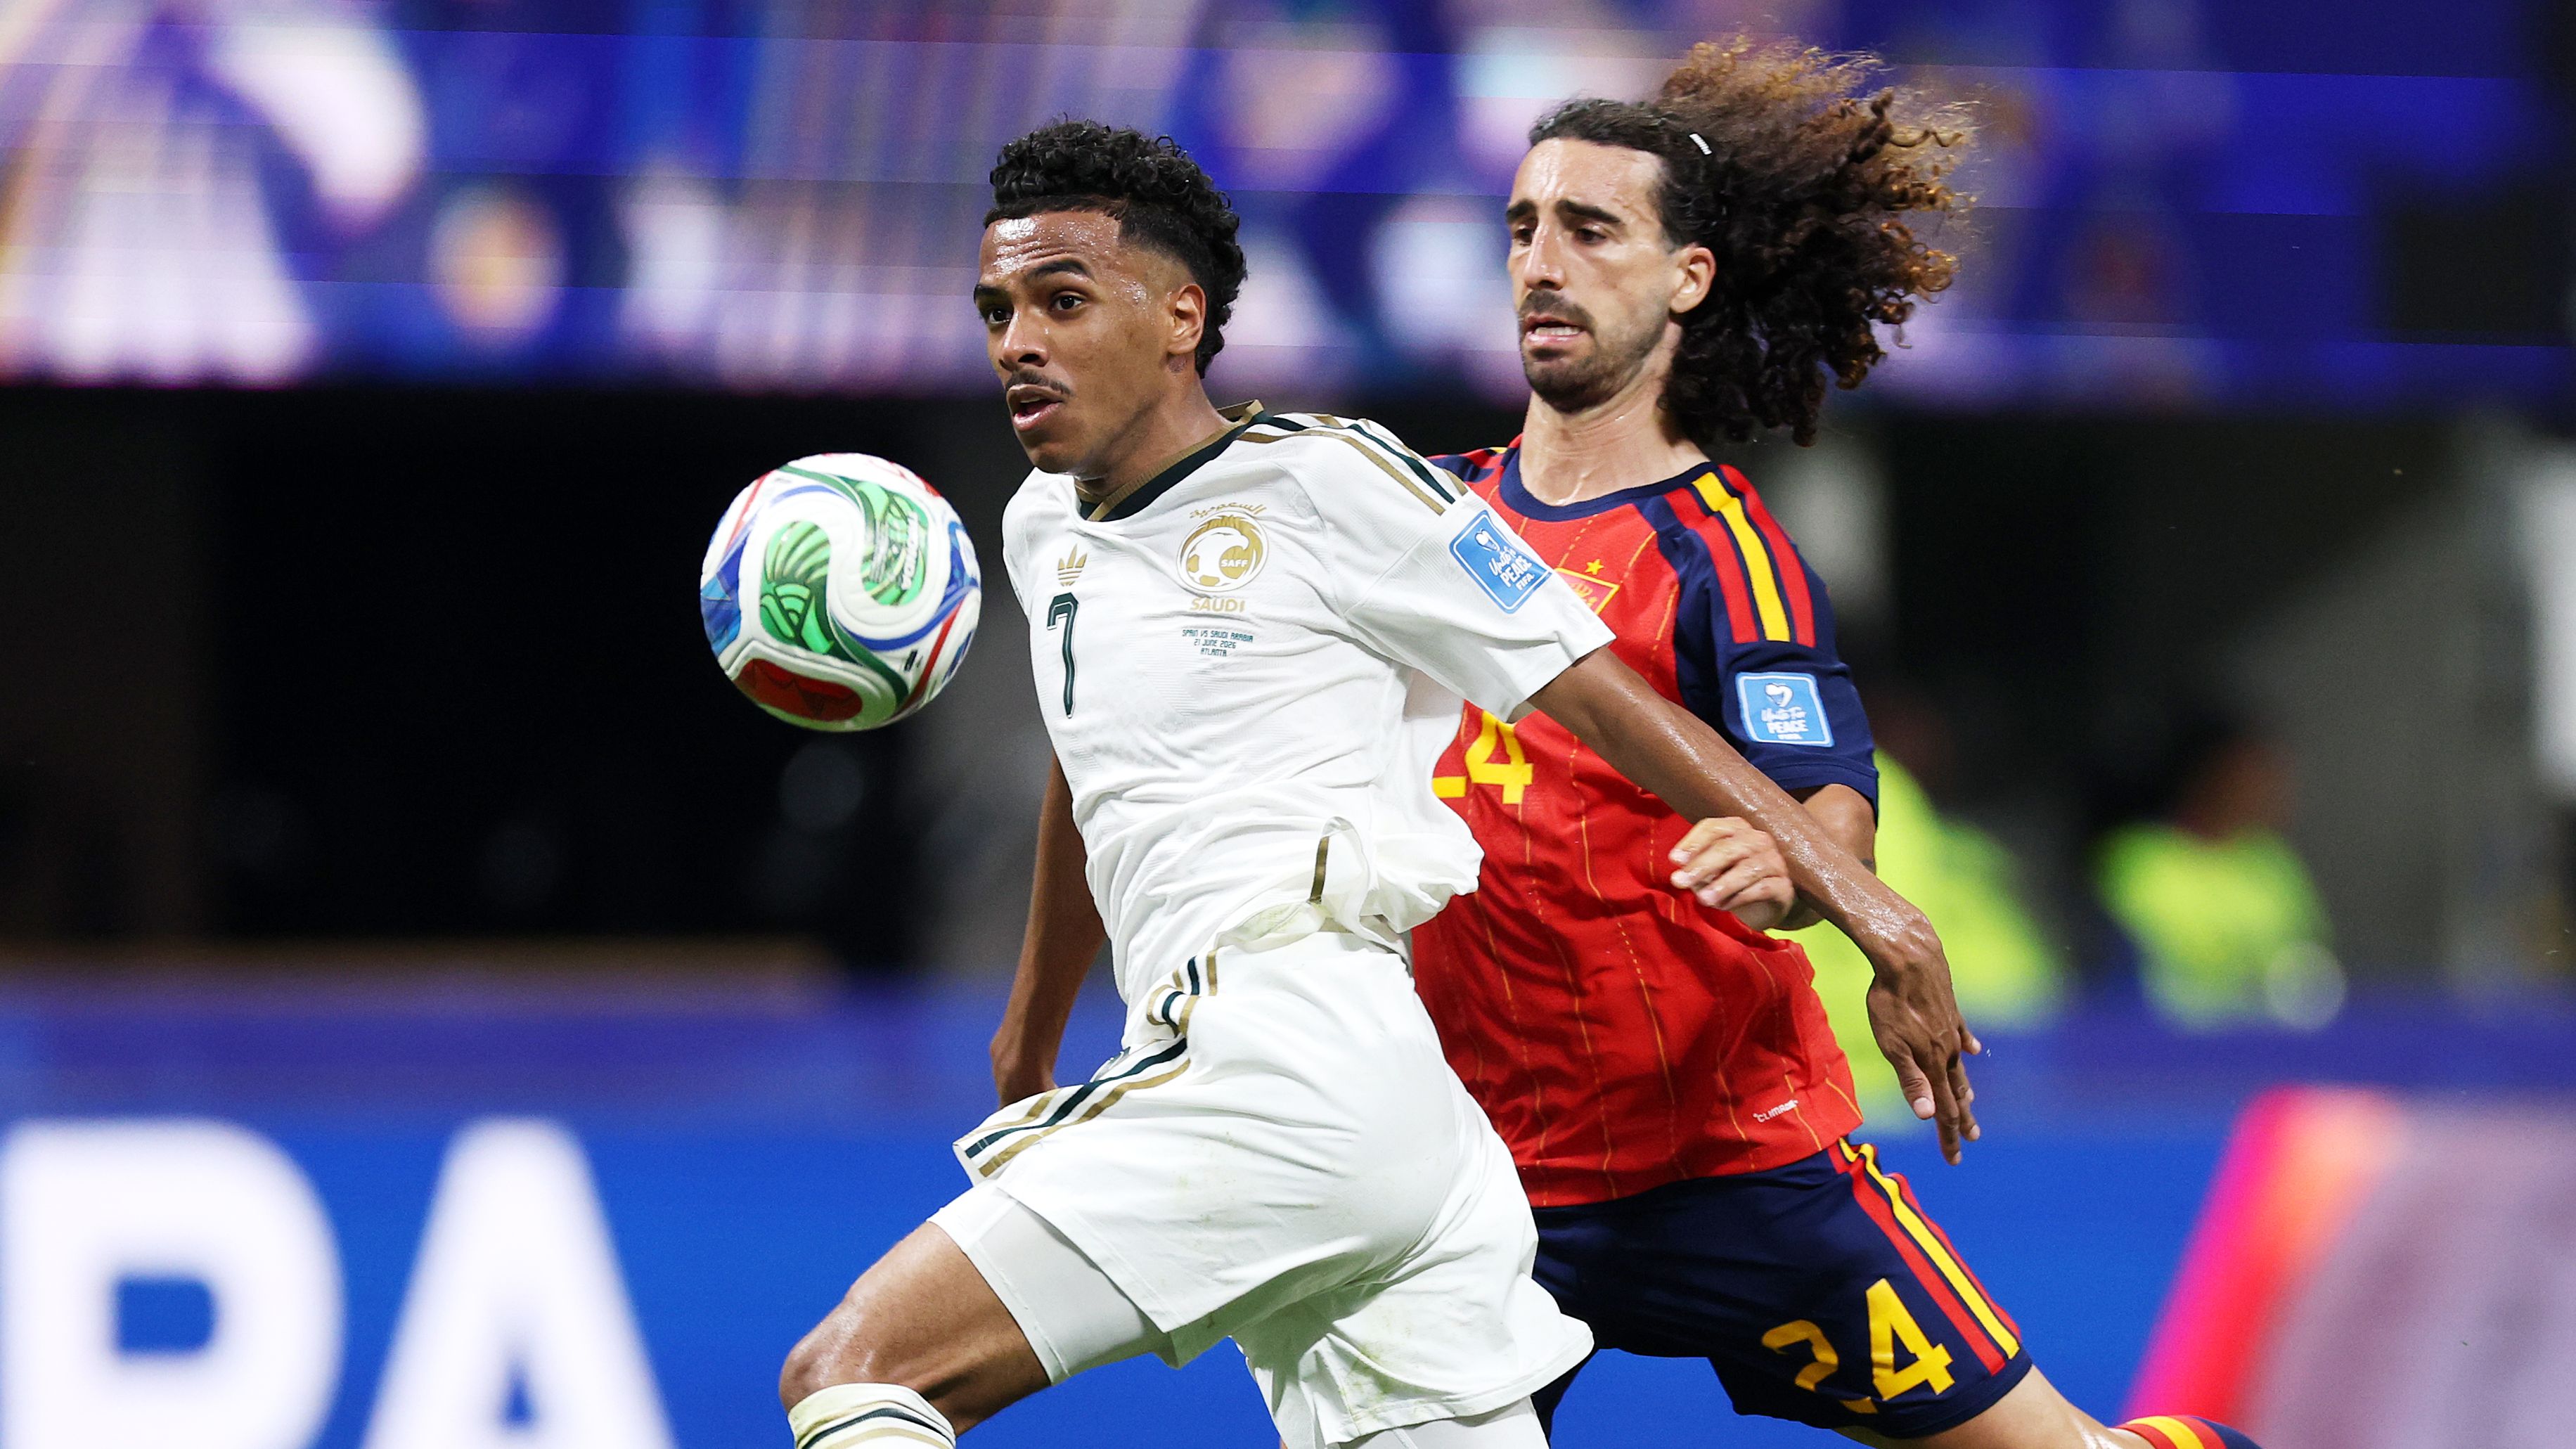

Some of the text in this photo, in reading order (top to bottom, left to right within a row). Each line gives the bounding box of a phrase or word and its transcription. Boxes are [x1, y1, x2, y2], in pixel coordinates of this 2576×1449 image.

[1500, 555, 1533, 588] PEACE
[1516, 573, 1535, 591] FIFA
[1190, 598, 1246, 612] SAUDI
[1202, 638, 1218, 647] JUNE
[1220, 640, 1237, 649] 2026
[1210, 630, 1228, 639] SAUDI
[1230, 632, 1254, 643] ARABIA
[1047, 592, 1079, 719] 7
[1201, 648, 1227, 657] ATLANTA
[1432, 709, 1534, 804] 4
[1761, 1277, 1956, 1414] 24
